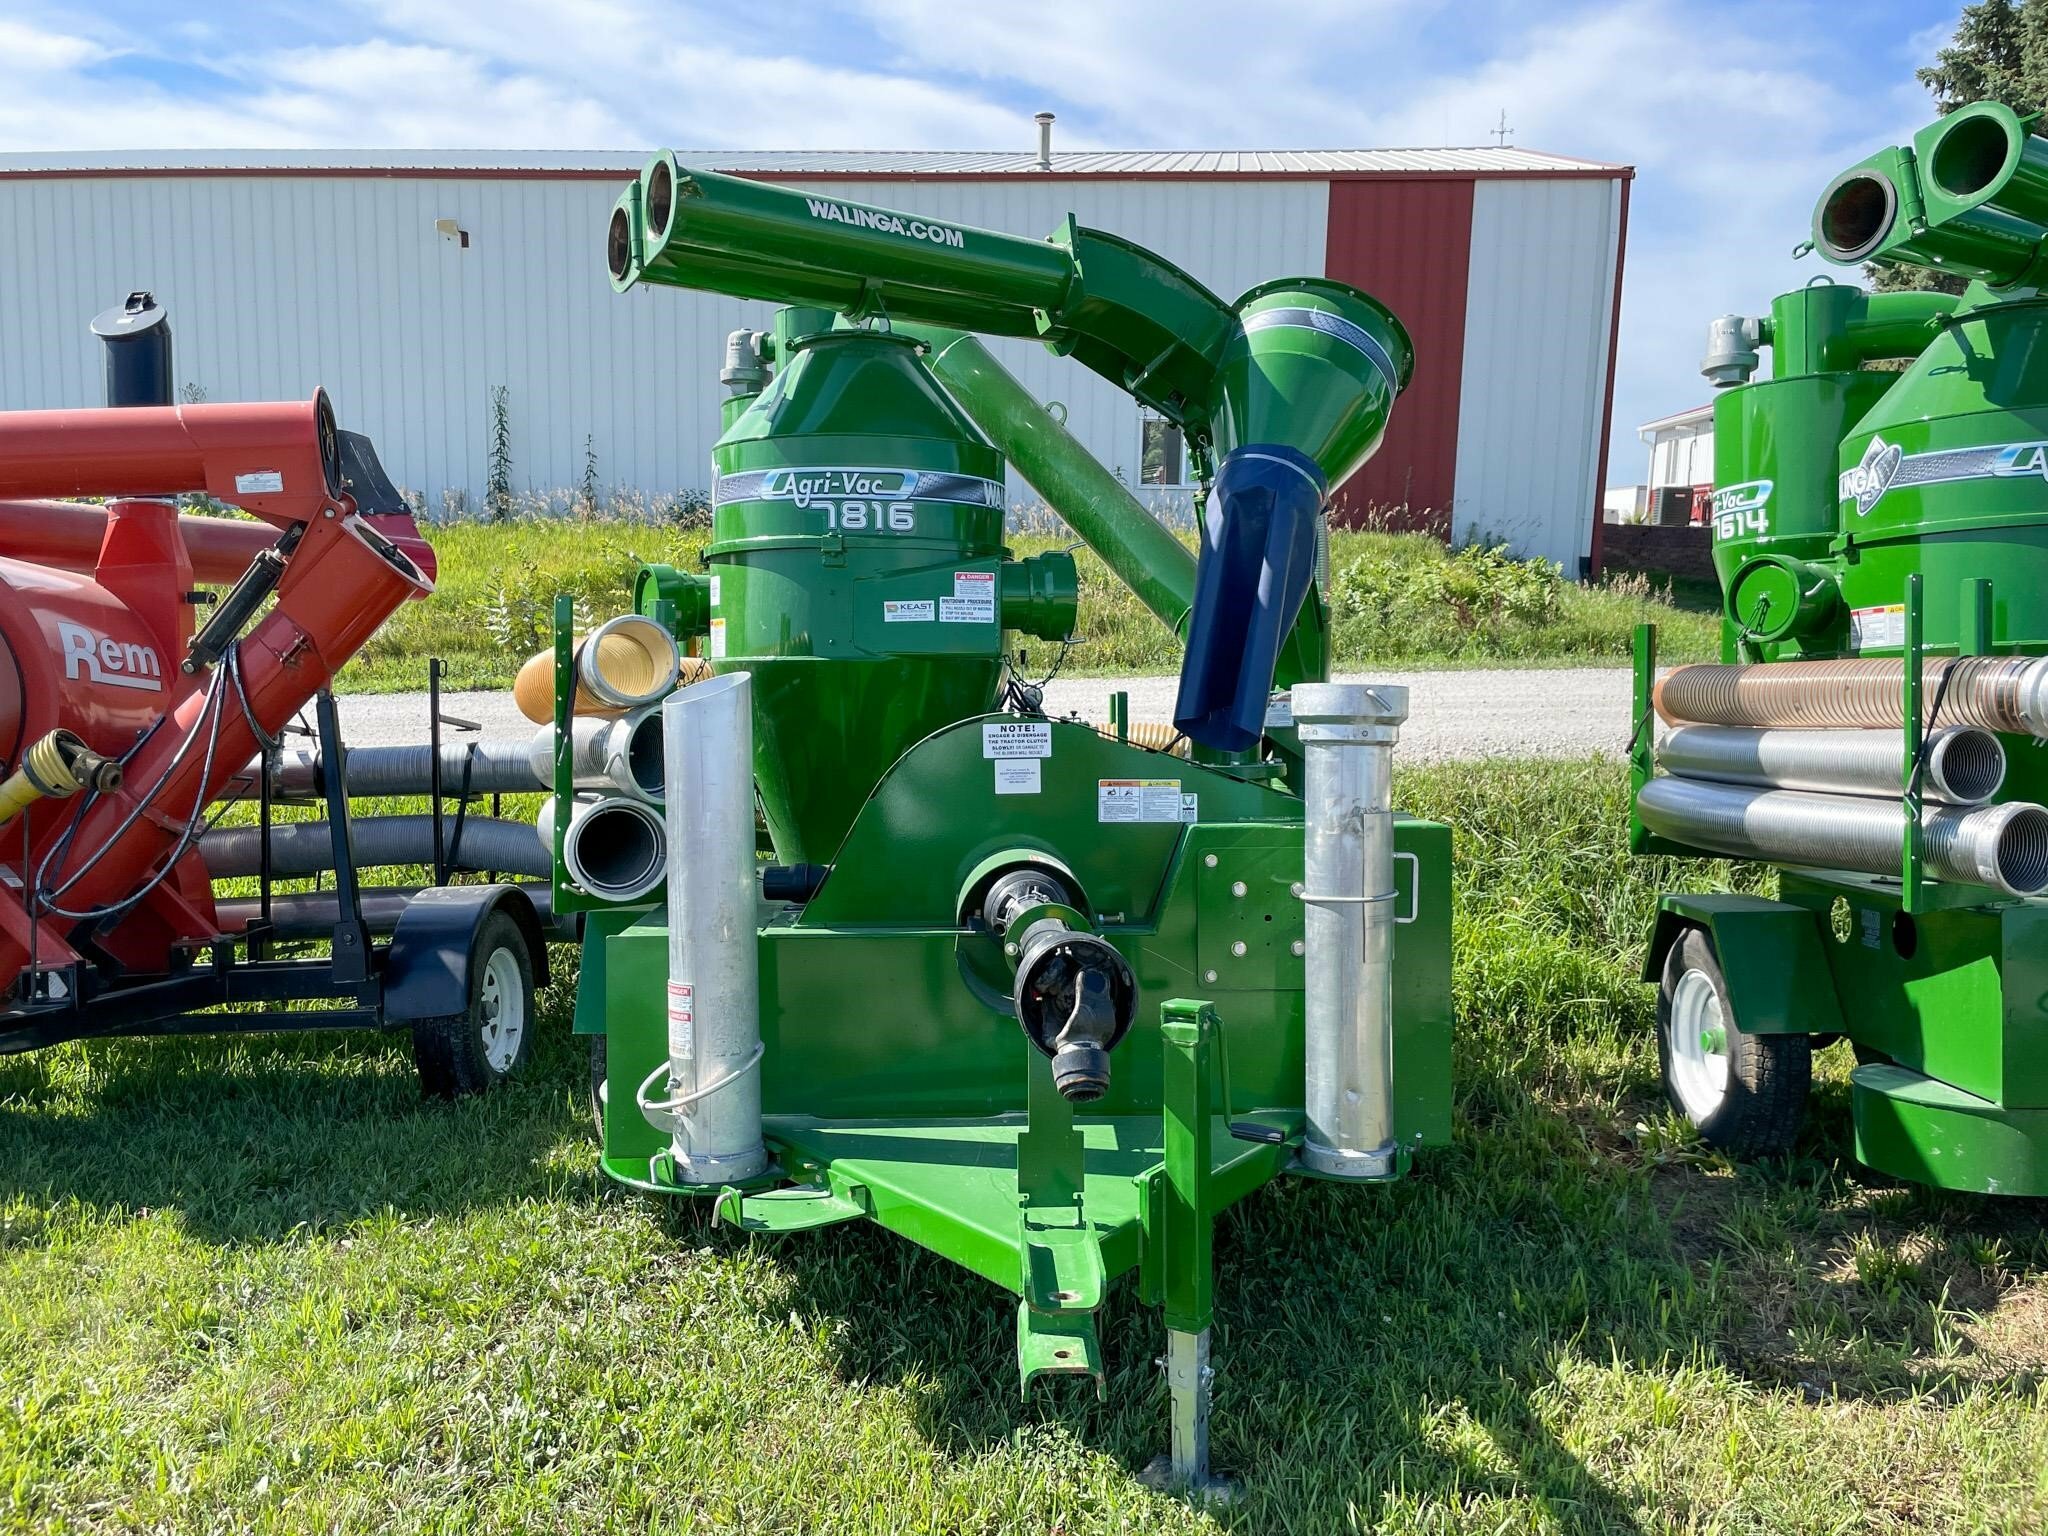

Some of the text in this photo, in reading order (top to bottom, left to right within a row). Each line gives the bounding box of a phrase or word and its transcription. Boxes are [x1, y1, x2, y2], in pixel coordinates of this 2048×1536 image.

[785, 472, 883, 508] Agri-Vac
[809, 501, 915, 532] 7816
[900, 602, 933, 610] KEAST
[57, 622, 161, 691] Rem
[1000, 724, 1035, 732] NOTE!
